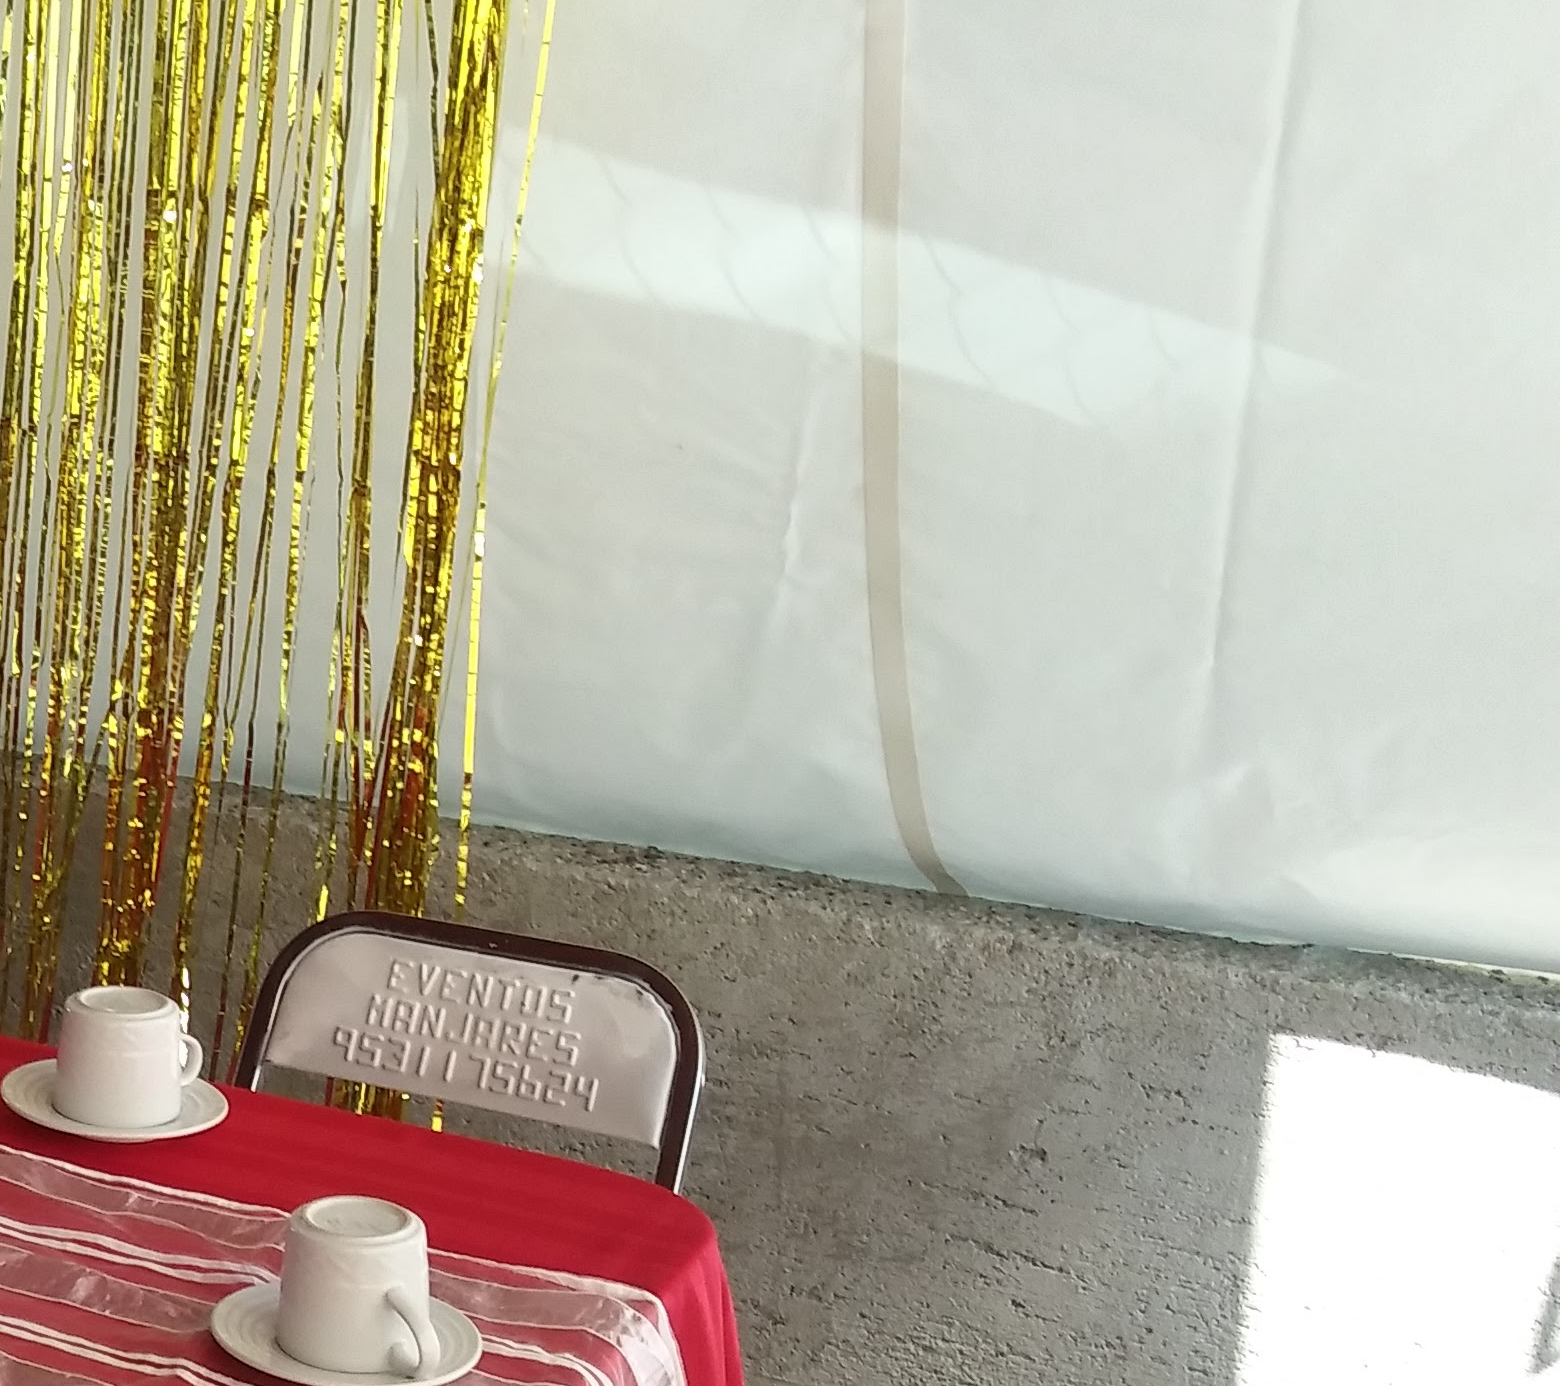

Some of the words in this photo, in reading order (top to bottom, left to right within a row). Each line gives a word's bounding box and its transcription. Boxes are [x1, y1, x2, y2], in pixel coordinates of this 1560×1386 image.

[387, 958, 576, 1025] EVENTOS
[366, 993, 582, 1067] MANJARES
[332, 1025, 600, 1112] 9531175624
